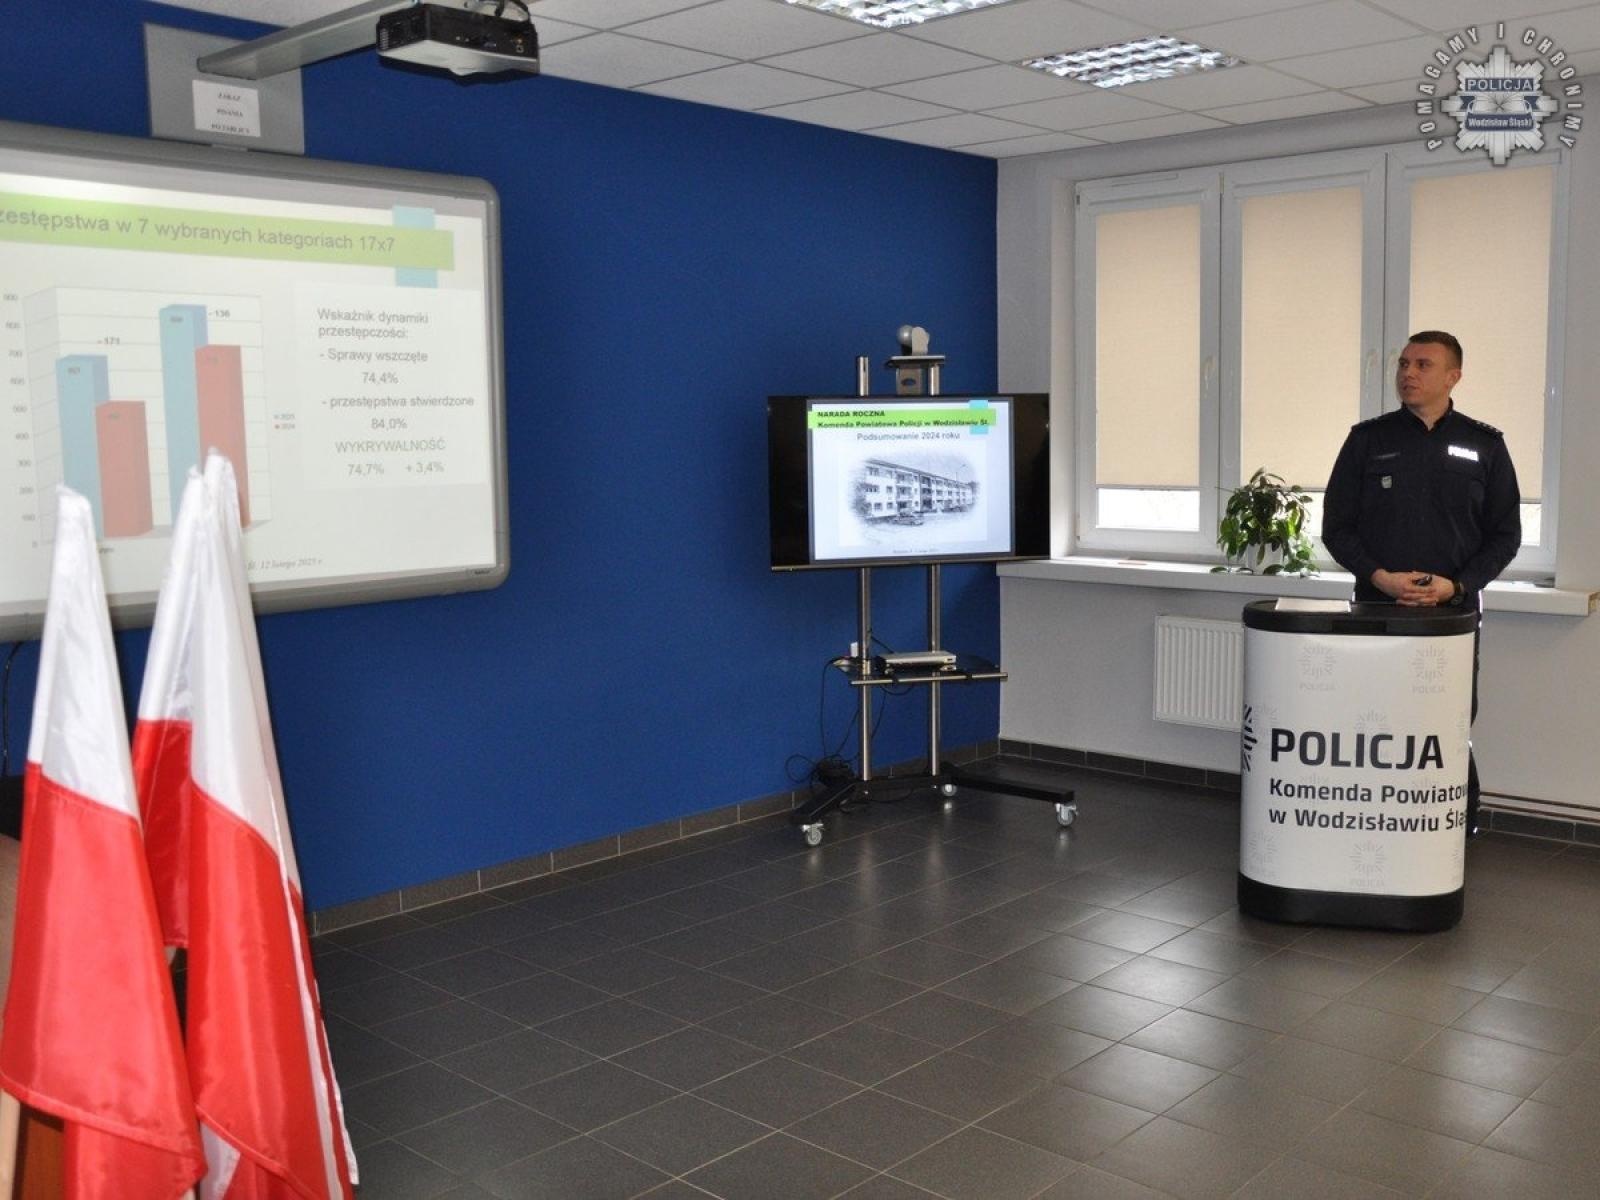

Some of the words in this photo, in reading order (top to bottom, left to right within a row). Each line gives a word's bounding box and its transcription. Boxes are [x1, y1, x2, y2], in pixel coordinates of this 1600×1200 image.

[115, 220, 132, 233] w
[137, 218, 149, 234] 7
[155, 221, 252, 245] wybranych
[258, 229, 353, 250] kategoriach
[360, 236, 396, 252] 17x7
[378, 310, 429, 325] dynamiki
[328, 348, 372, 363] Sprawy
[362, 371, 399, 385] 74,4%
[856, 432, 920, 441] Podsumowanie
[921, 431, 940, 440] 2024
[942, 431, 961, 440] roku
[1271, 728, 1444, 770] POLICJA
[1270, 778, 1372, 802] Komenda
[1269, 808, 1286, 825] w
[1295, 809, 1440, 832] Wodzisławiu
